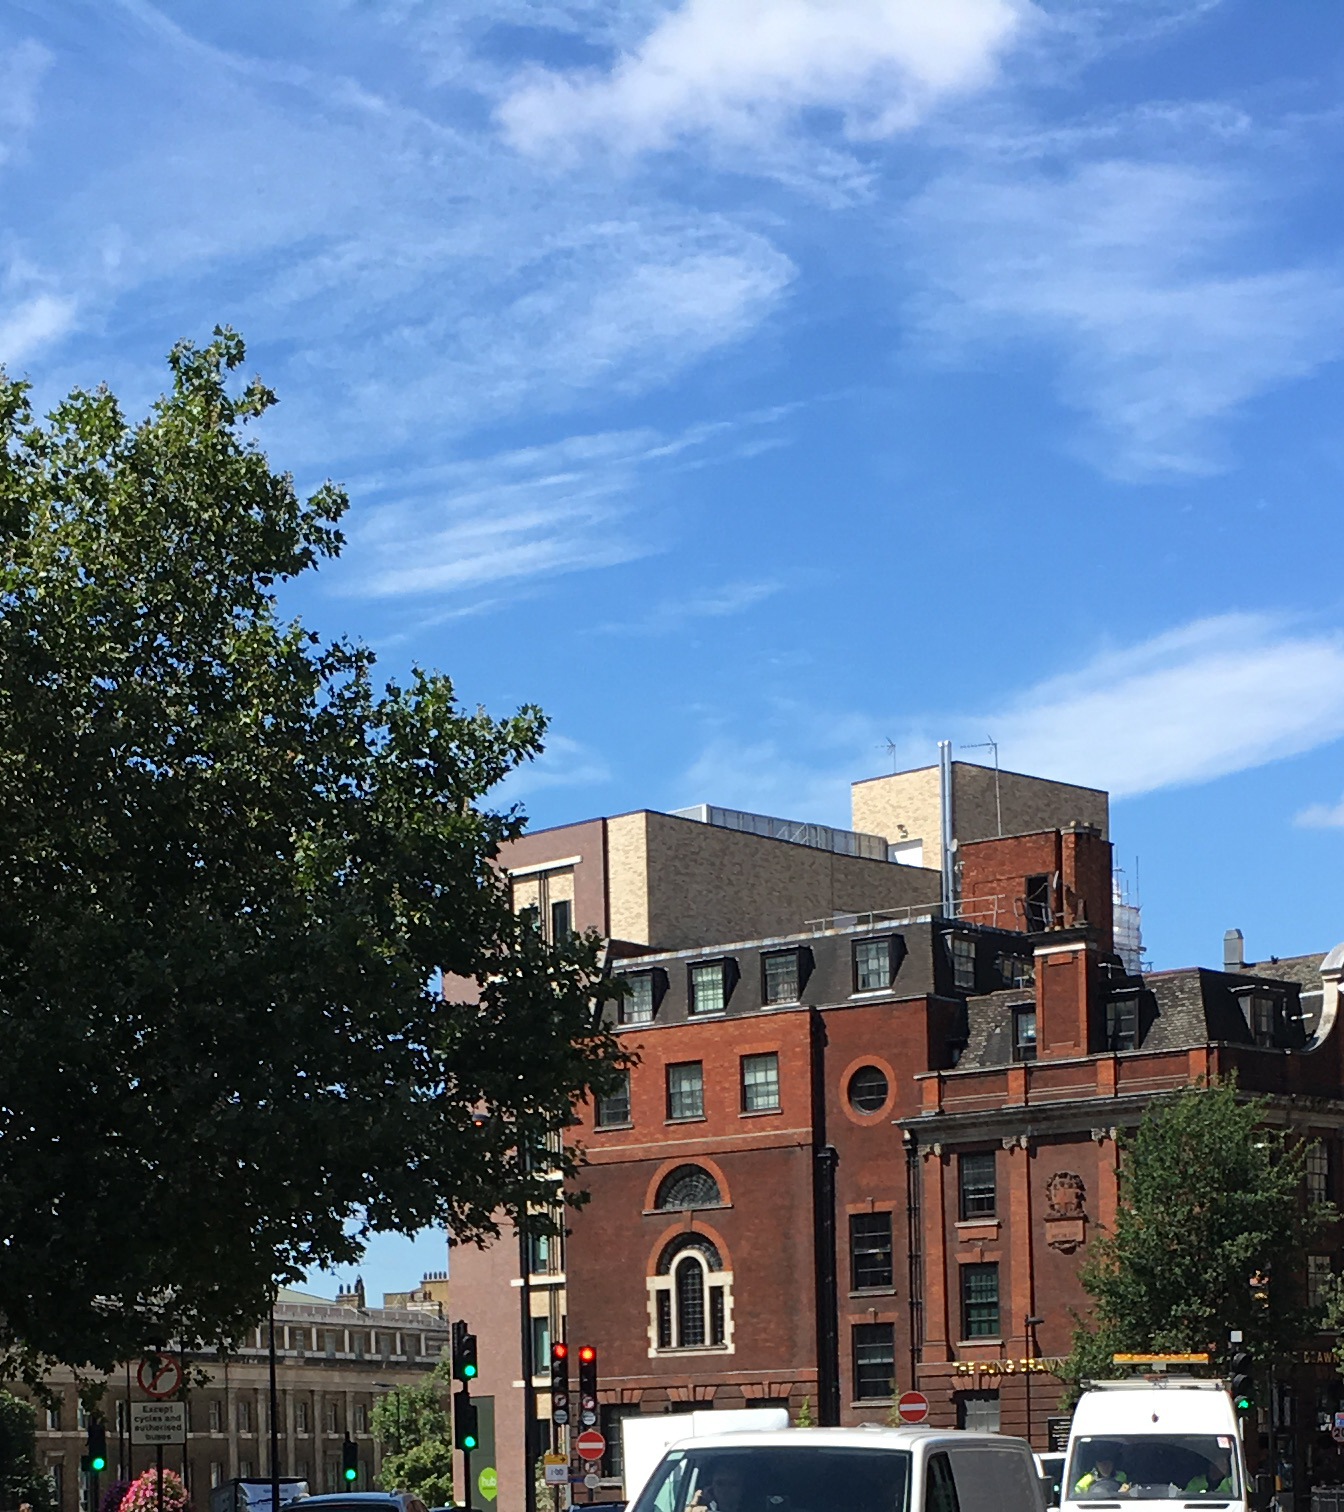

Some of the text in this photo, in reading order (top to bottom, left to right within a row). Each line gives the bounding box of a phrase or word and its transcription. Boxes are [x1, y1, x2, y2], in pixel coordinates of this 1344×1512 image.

[142, 1405, 174, 1414] Except
[134, 1414, 182, 1424] cycles and
[134, 1423, 182, 1432] authorised
